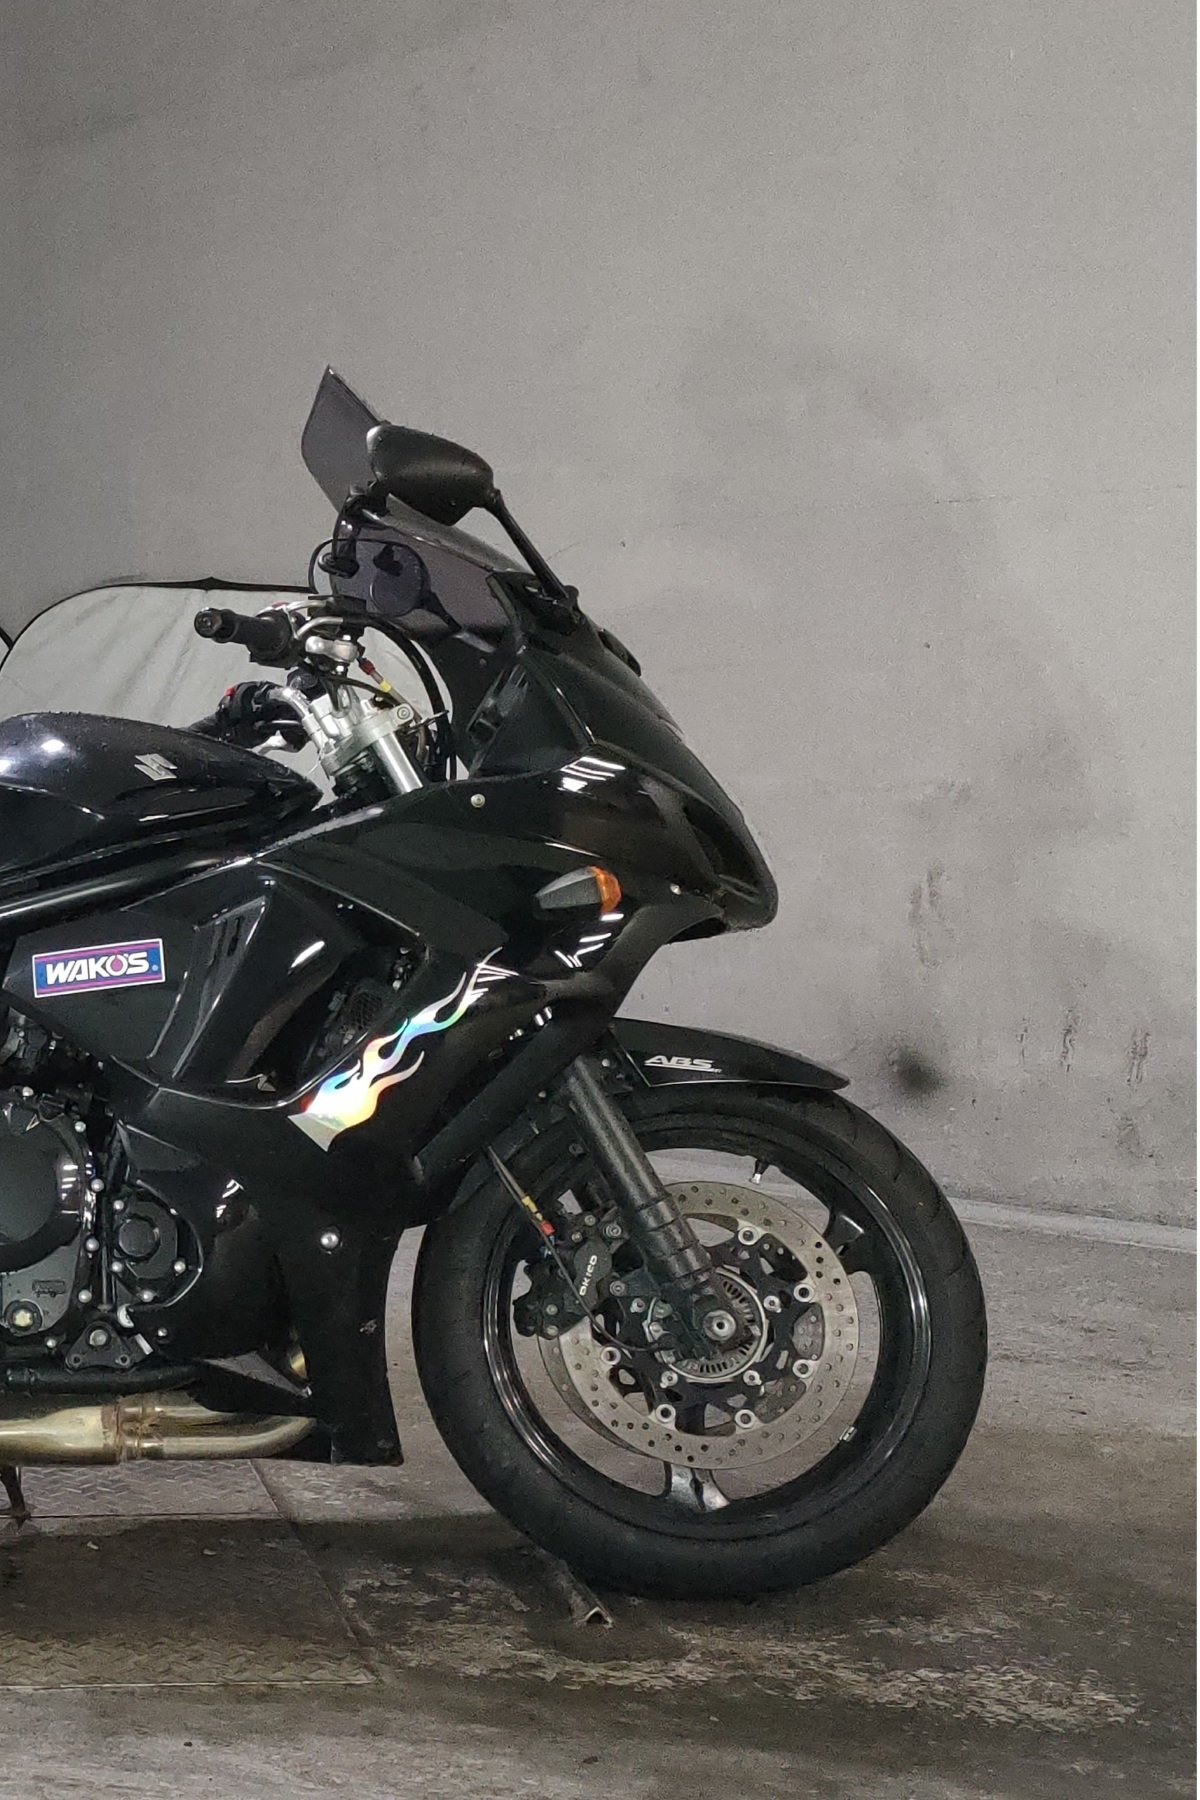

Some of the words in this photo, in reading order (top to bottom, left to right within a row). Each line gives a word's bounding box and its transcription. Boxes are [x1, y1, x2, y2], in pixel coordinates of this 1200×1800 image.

[46, 952, 150, 985] WAKO'S
[643, 1055, 715, 1070] ABS
[578, 1254, 598, 1301] OKICO
